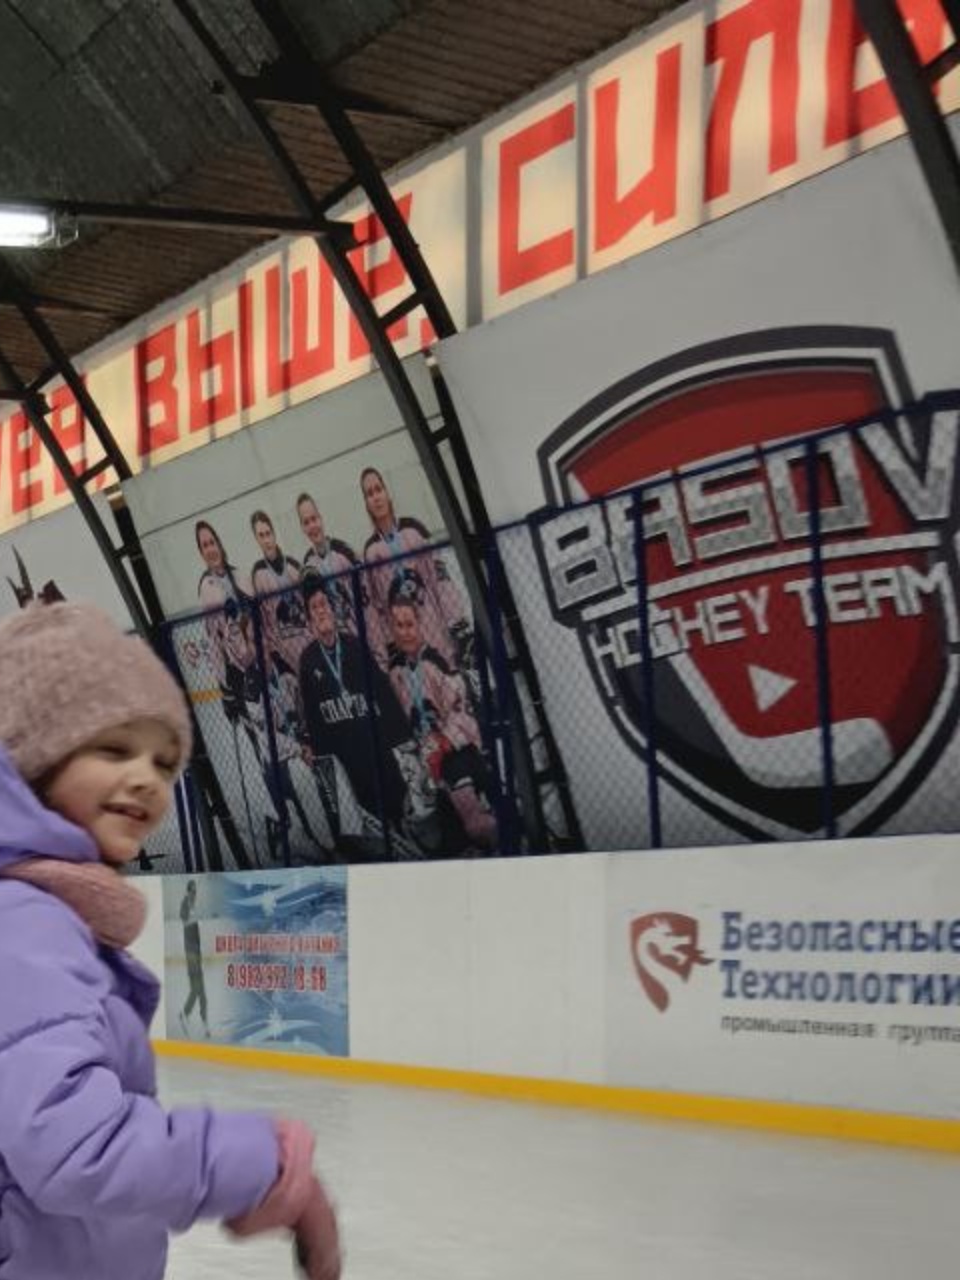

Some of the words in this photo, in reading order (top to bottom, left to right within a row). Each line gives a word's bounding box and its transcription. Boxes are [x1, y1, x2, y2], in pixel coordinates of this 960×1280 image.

[539, 409, 960, 612] BASOV
[588, 586, 770, 670] HOCKEY
[783, 560, 950, 627] TEAM
[721, 911, 960, 954] Безопасные
[720, 959, 960, 1007] Технологии
[721, 1013, 877, 1038] промышленная
